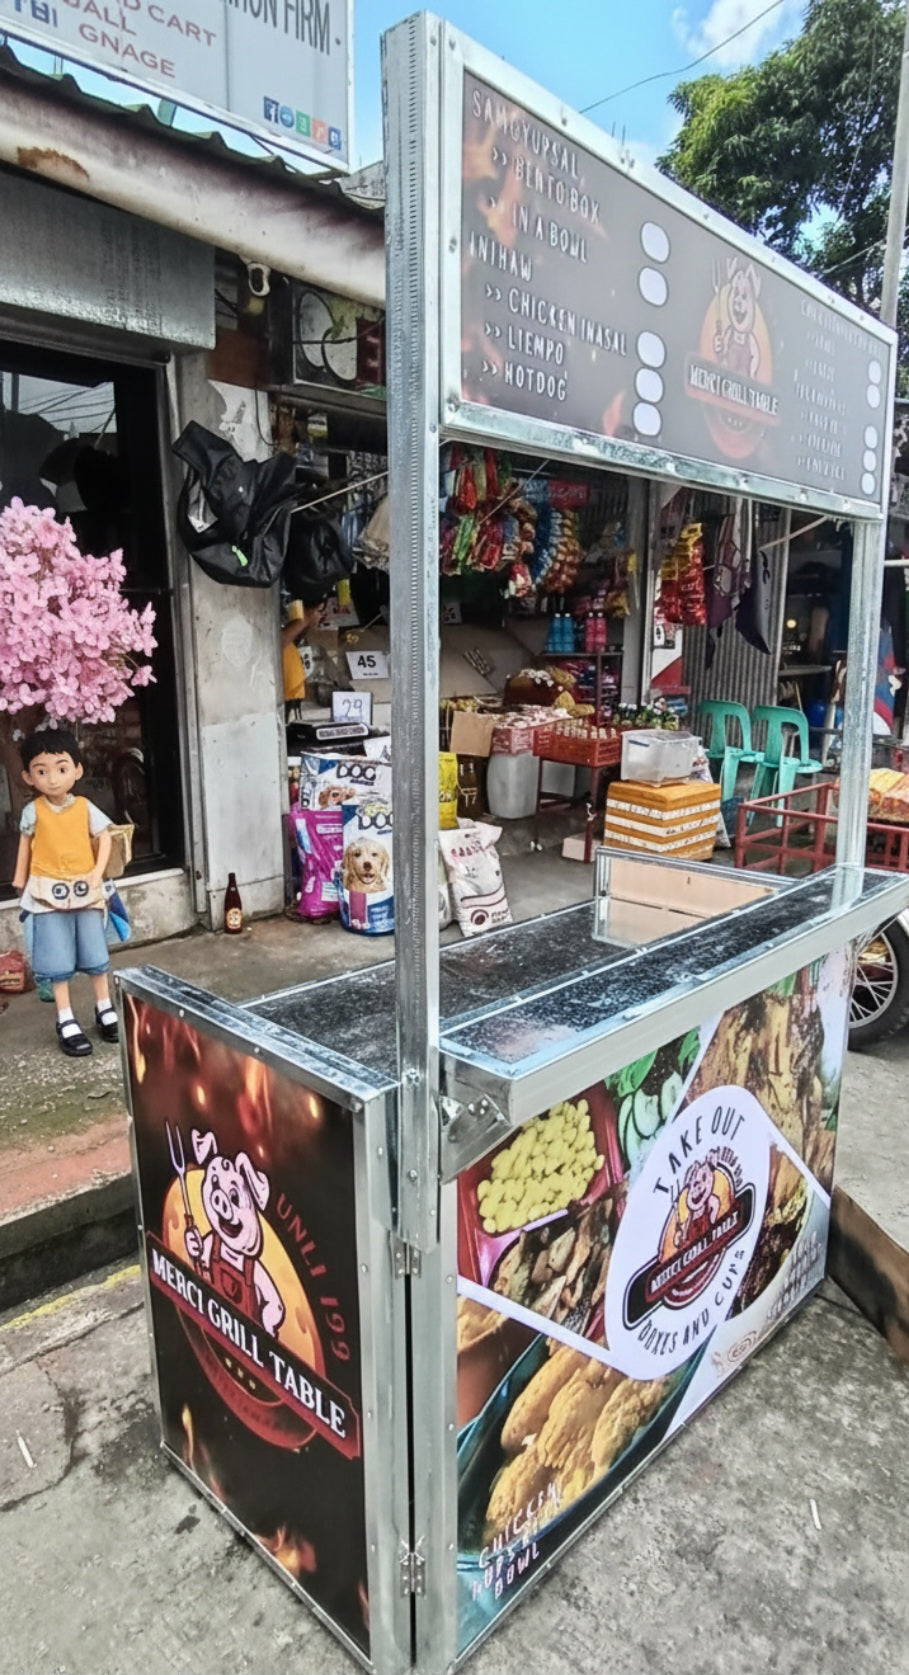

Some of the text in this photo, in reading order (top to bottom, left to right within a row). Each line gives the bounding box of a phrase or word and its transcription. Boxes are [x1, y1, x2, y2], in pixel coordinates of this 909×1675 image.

[78, 23, 176, 78] GNAGE
[147, 5, 217, 47] CART
[472, 89, 578, 180] SAMGYUPSAL
[569, 186, 600, 225] BOX
[469, 231, 532, 282] INIHAW
[513, 202, 587, 264] IN A BOWL
[508, 287, 627, 356] CHICKEN INASAL
[508, 324, 564, 366] LIEMPO
[504, 361, 567, 401] HOTDOG
[357, 655, 377, 668] 45
[336, 763, 377, 781] DOG
[357, 811, 394, 831] DO
[652, 1115, 702, 1194] TAKE
[711, 1105, 746, 1141] OUT
[276, 1193, 328, 1278] UNLI
[151, 1248, 348, 1440] MERCI GRILL TABLE
